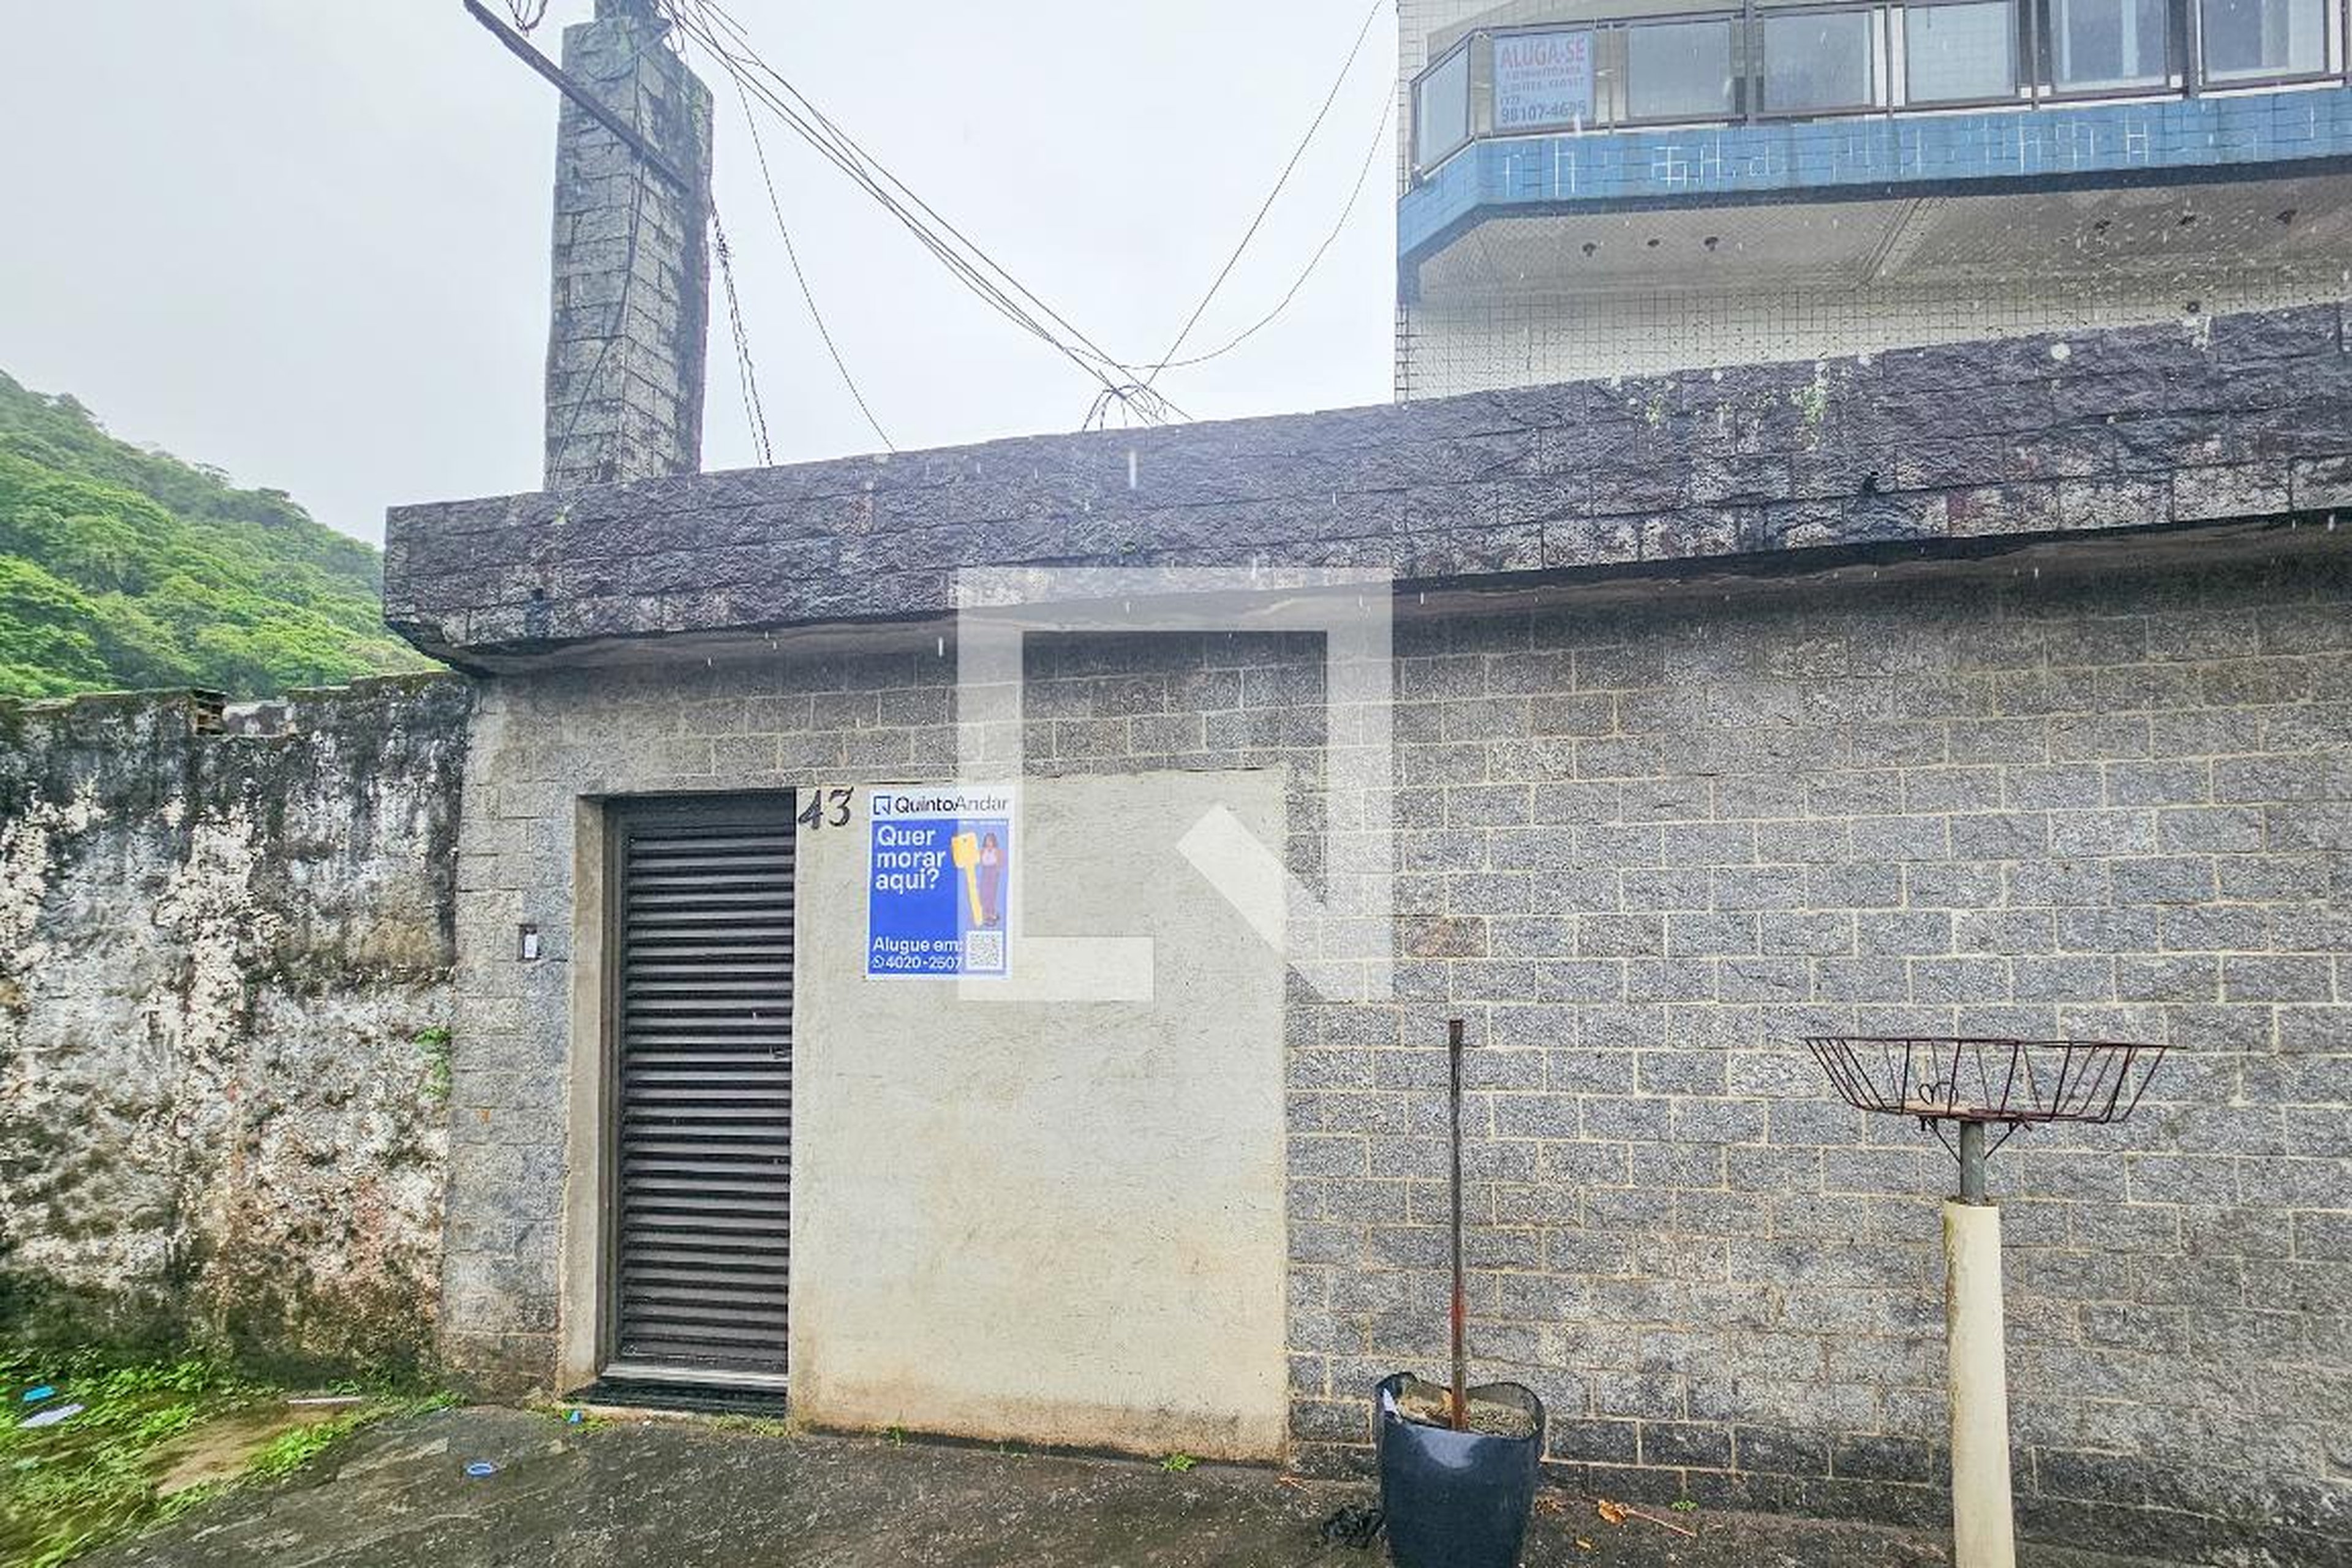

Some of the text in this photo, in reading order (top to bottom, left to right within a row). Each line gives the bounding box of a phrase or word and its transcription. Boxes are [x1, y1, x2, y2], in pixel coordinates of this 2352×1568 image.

[1500, 37, 1585, 69] ALUGA-SE
[798, 786, 854, 829] 43
[895, 796, 1008, 813] QuintoAndar
[877, 825, 936, 846] Quer
[876, 850, 946, 869] morar
[875, 869, 940, 894] aqui?
[873, 937, 930, 955] Alugue
